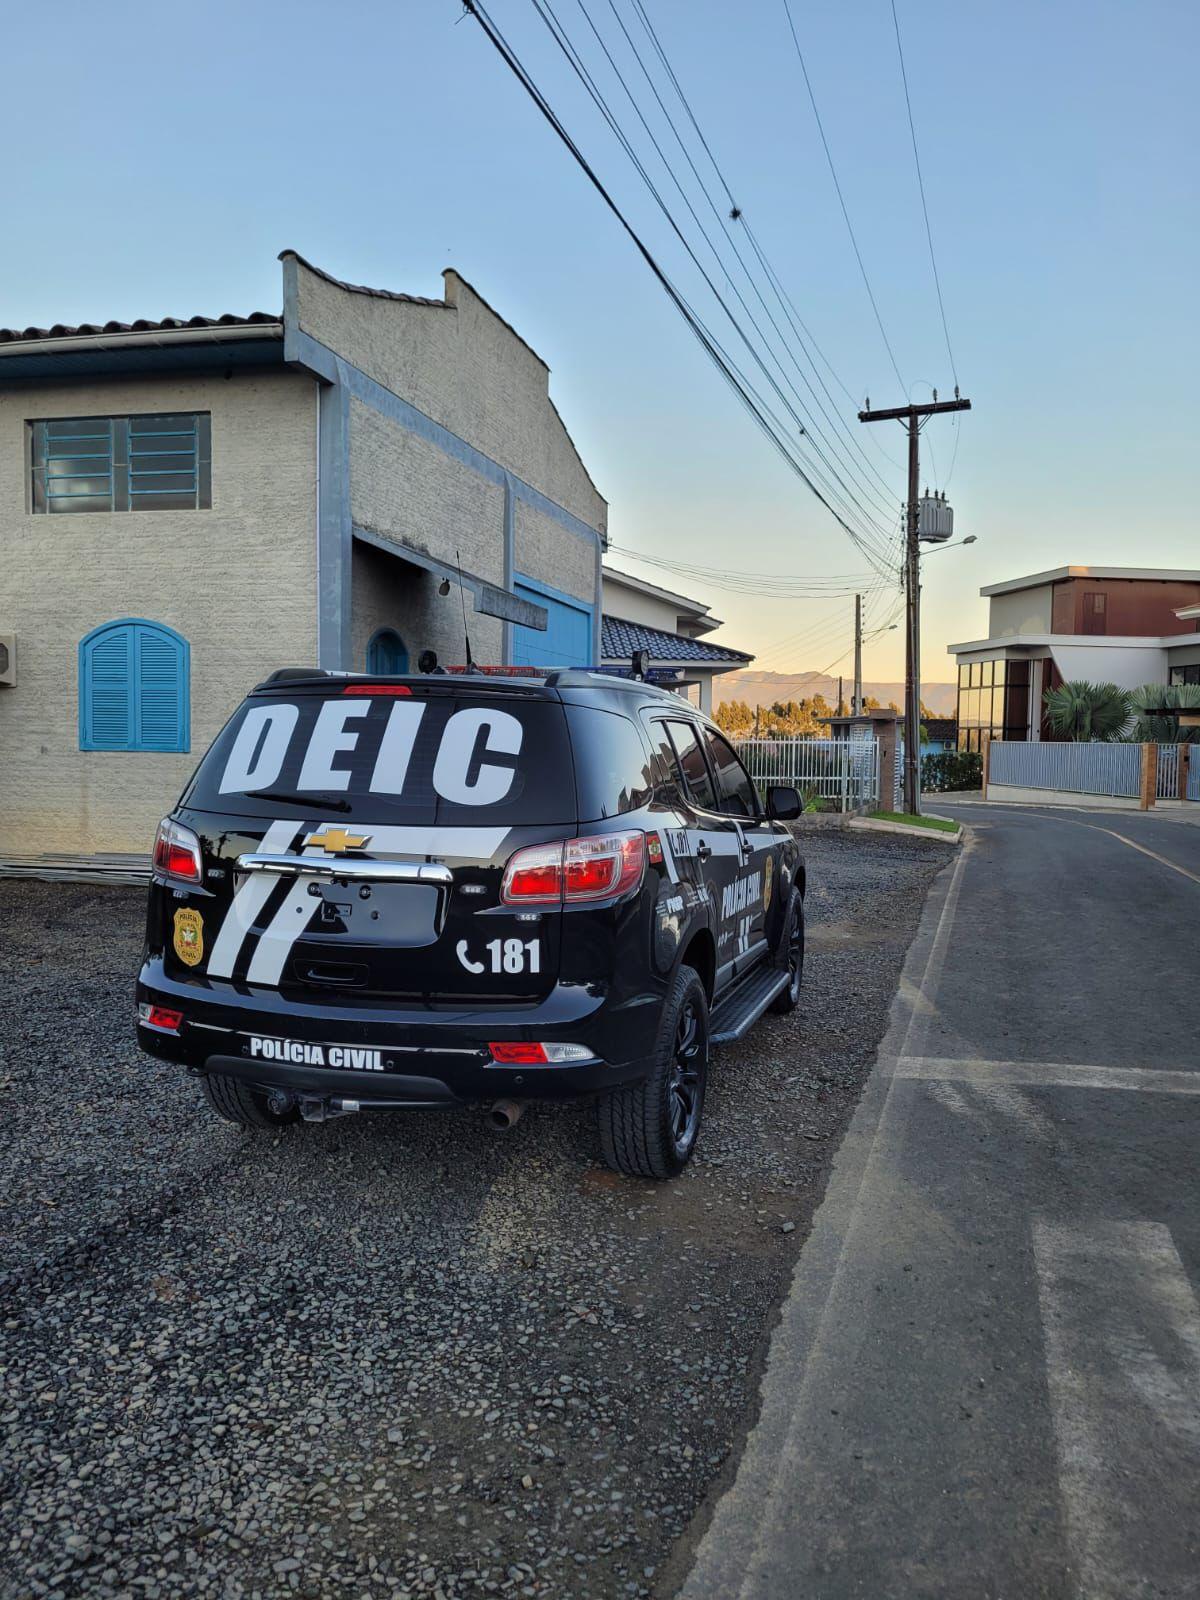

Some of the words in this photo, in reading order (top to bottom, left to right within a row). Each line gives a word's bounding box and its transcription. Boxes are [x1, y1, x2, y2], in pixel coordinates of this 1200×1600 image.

[218, 699, 523, 806] DEIC
[486, 938, 540, 973] 181
[250, 1038, 325, 1066] POLÍCIA
[329, 1047, 384, 1070] CIVIL
